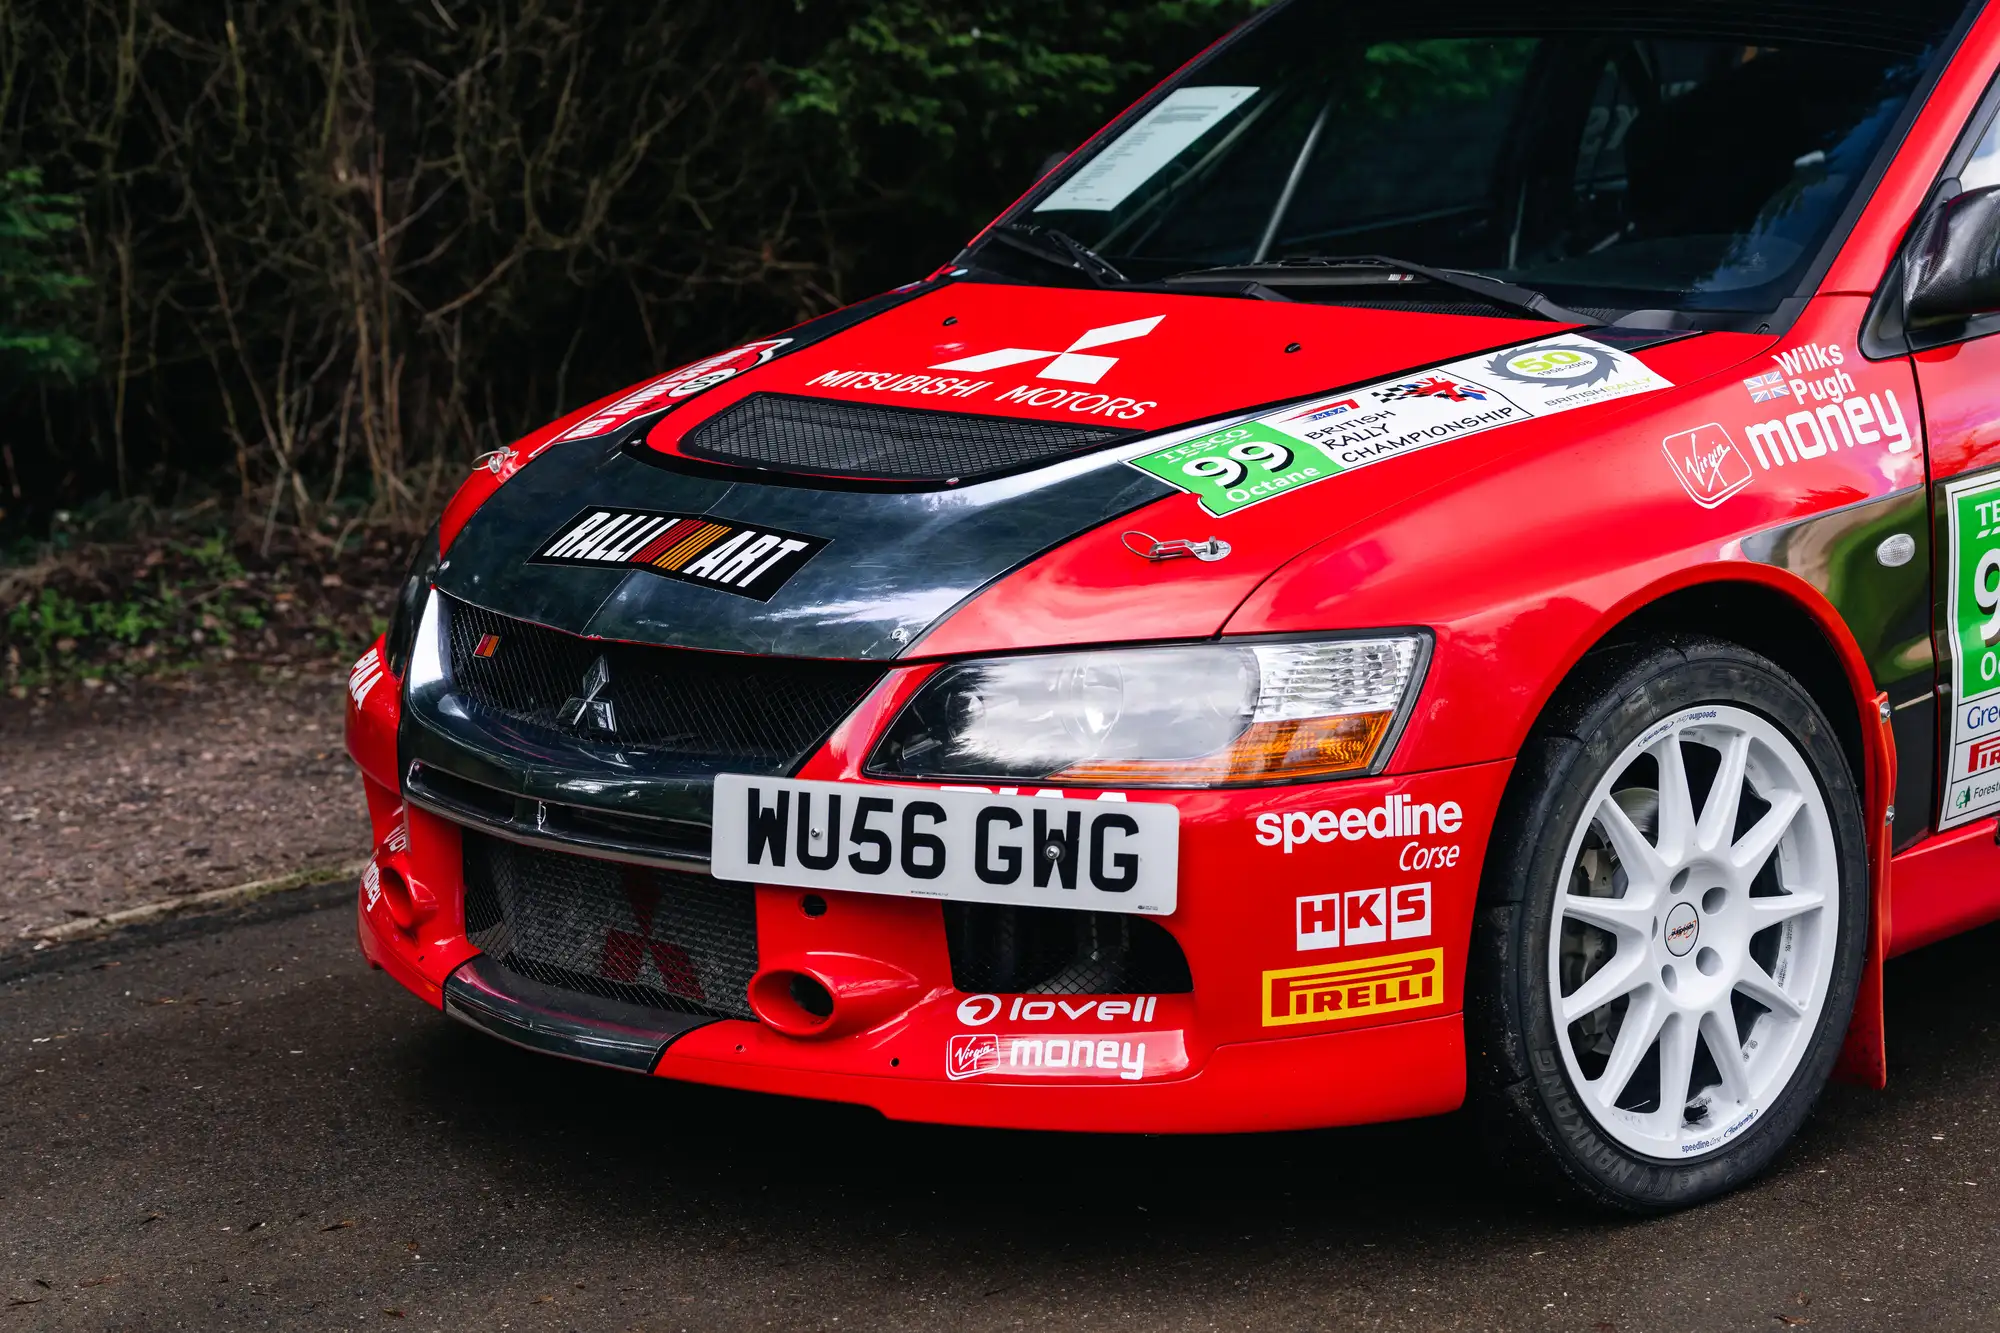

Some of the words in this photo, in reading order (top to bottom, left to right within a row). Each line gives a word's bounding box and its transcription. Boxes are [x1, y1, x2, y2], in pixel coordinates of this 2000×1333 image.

[1512, 351, 1582, 373] 50
[1771, 342, 1844, 377] Wilks
[805, 369, 994, 399] MITSUBISHI
[994, 384, 1158, 420] MOTORS
[1788, 368, 1856, 404] Pugh
[1304, 410, 1397, 441] BRITISH
[1313, 406, 1348, 422] MSA
[1154, 429, 1249, 460] TESCO
[1321, 422, 1391, 451] RALLY
[1341, 406, 1514, 464] CHAMPIONSHIP
[1684, 432, 1731, 493] Virgin
[1744, 389, 1912, 471] money
[1182, 441, 1295, 489] 99
[1225, 466, 1321, 503] Octane
[1967, 706, 2000, 729] Gre
[1973, 781, 2000, 799] Forest
[747, 787, 947, 880] WU56
[974, 805, 1140, 893] GWG
[1255, 793, 1463, 854] speedline
[1399, 841, 1460, 872] Corse
[1298, 885, 1428, 940] HKS
[1270, 957, 1436, 1018] PIRELLI
[1009, 996, 1157, 1023] lovell
[954, 1036, 995, 1071] Virgin
[1009, 1039, 1146, 1081] money
[1681, 1138, 1710, 1154] speedline
